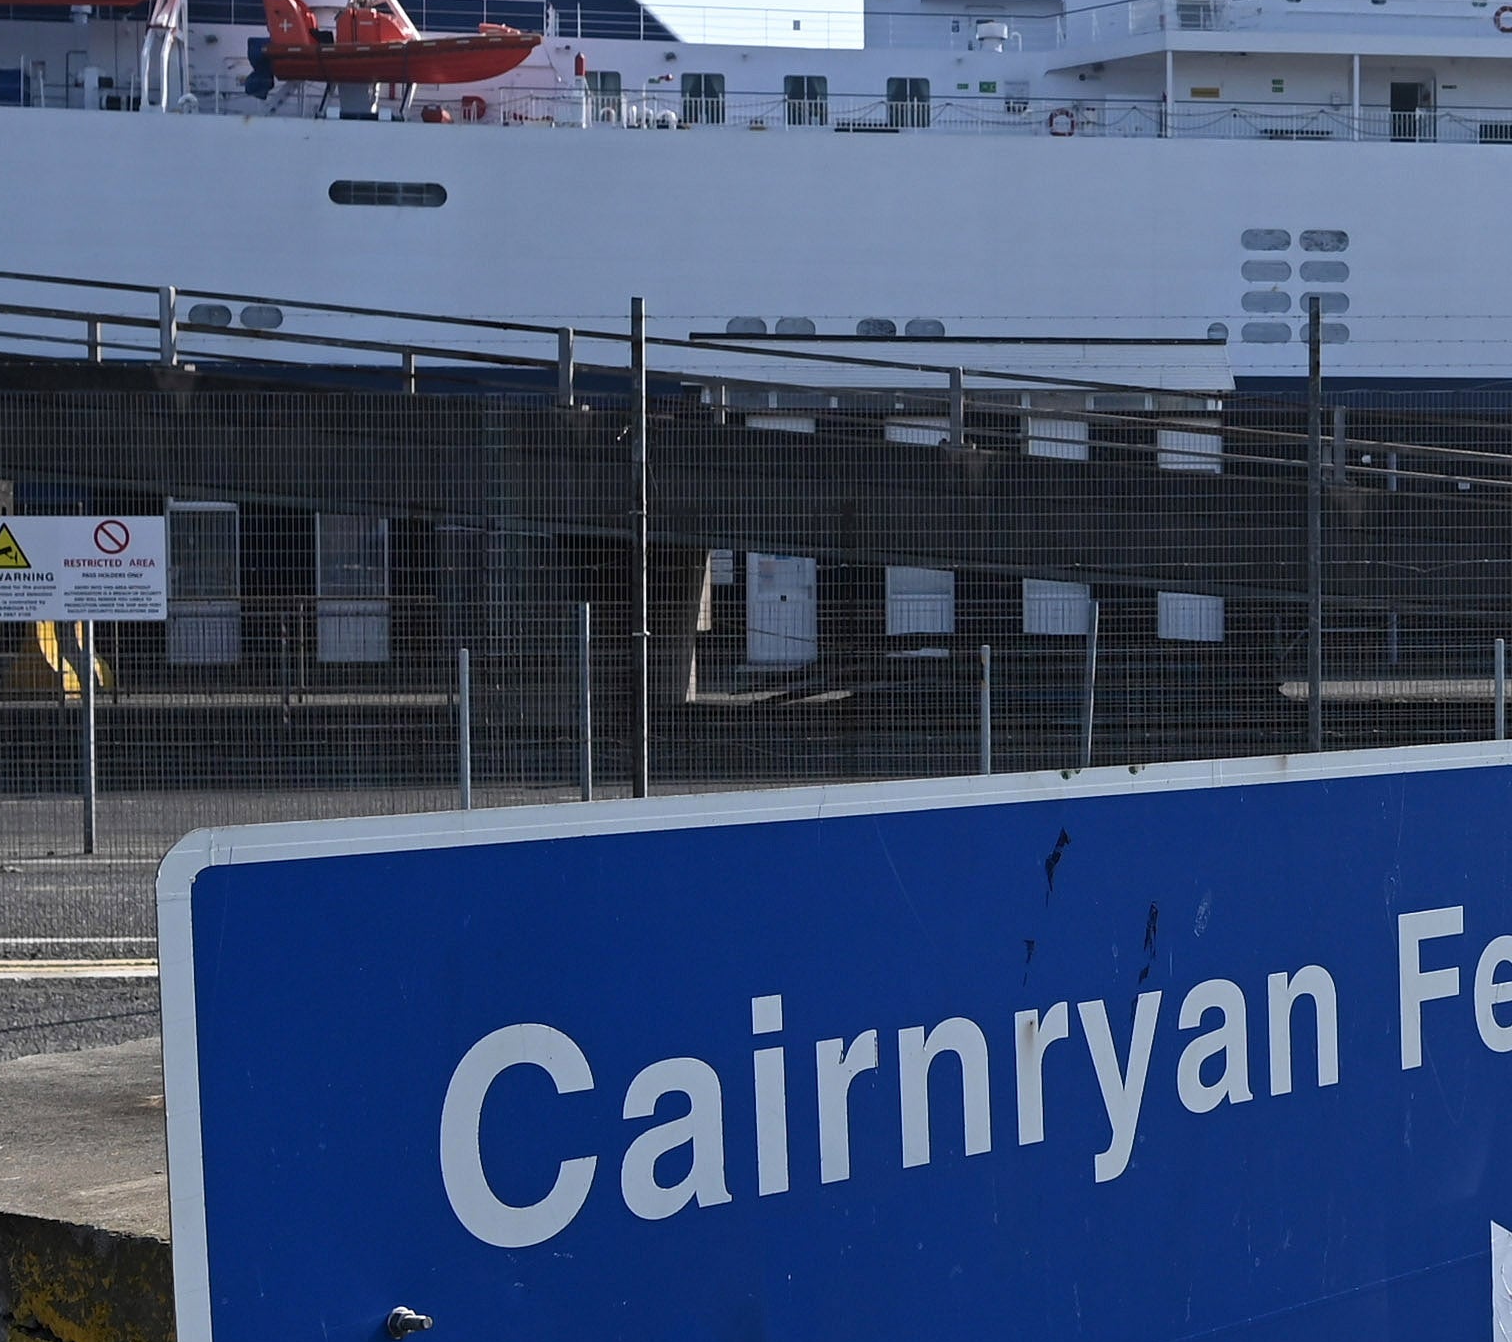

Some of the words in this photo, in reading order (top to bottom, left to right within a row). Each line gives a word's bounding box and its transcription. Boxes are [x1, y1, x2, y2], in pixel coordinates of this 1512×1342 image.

[63, 558, 122, 568] RESTRICTED
[129, 558, 155, 568] AREA
[439, 964, 1340, 1248] Cairnryan
